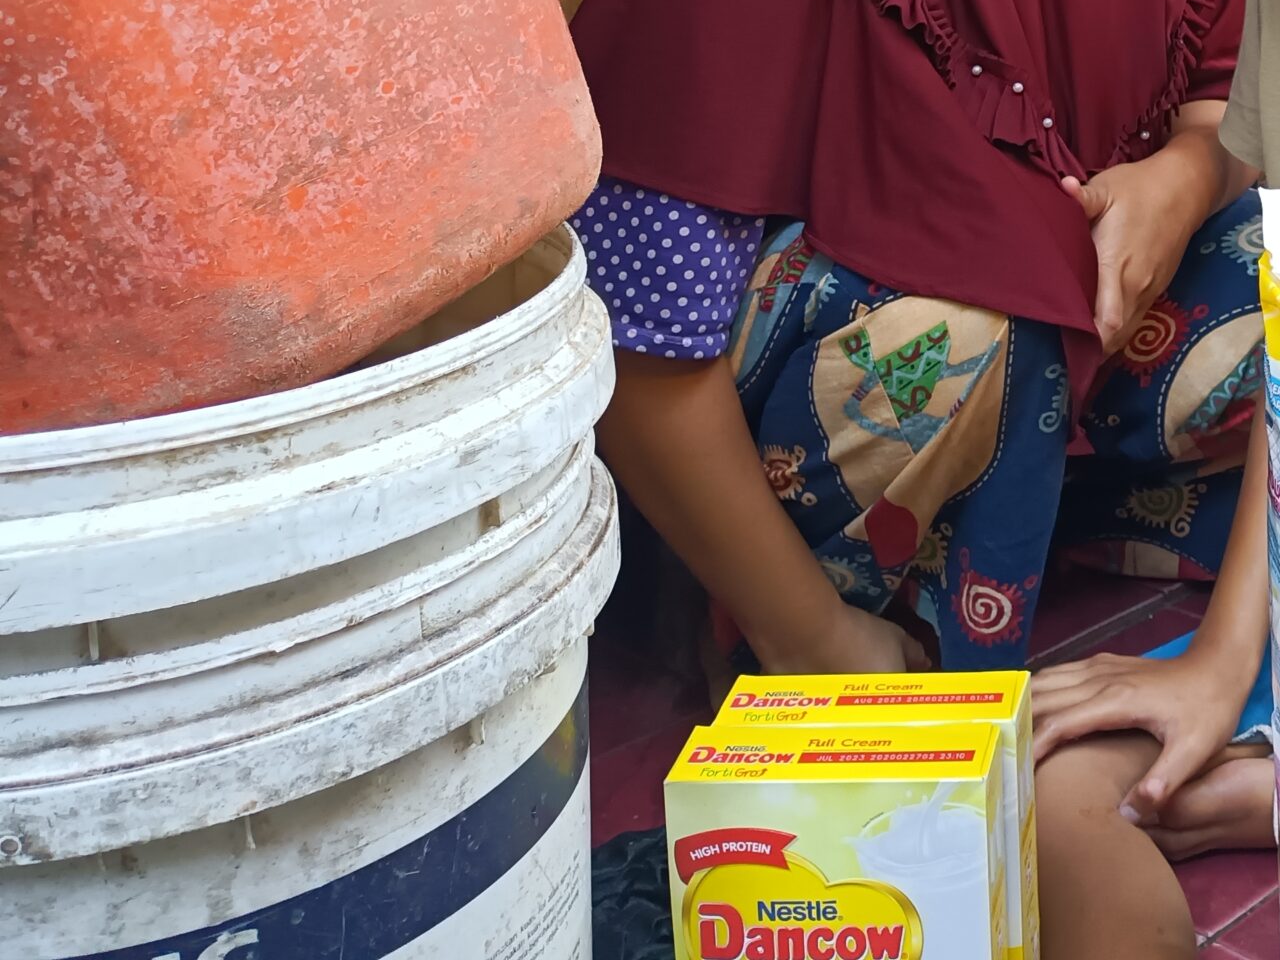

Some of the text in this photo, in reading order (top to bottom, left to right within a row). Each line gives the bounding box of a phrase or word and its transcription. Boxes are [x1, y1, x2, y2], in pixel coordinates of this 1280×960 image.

[843, 683, 924, 692] Full Cream
[730, 693, 832, 709] Dancow
[877, 696, 902, 704] 2023
[807, 738, 893, 748] Full Cream
[687, 746, 796, 764] Dancow
[839, 754, 866, 762] 2023
[689, 841, 772, 861] HIGH PROTEIN
[756, 900, 839, 922] Nestlé
[697, 901, 905, 960] Dancow
